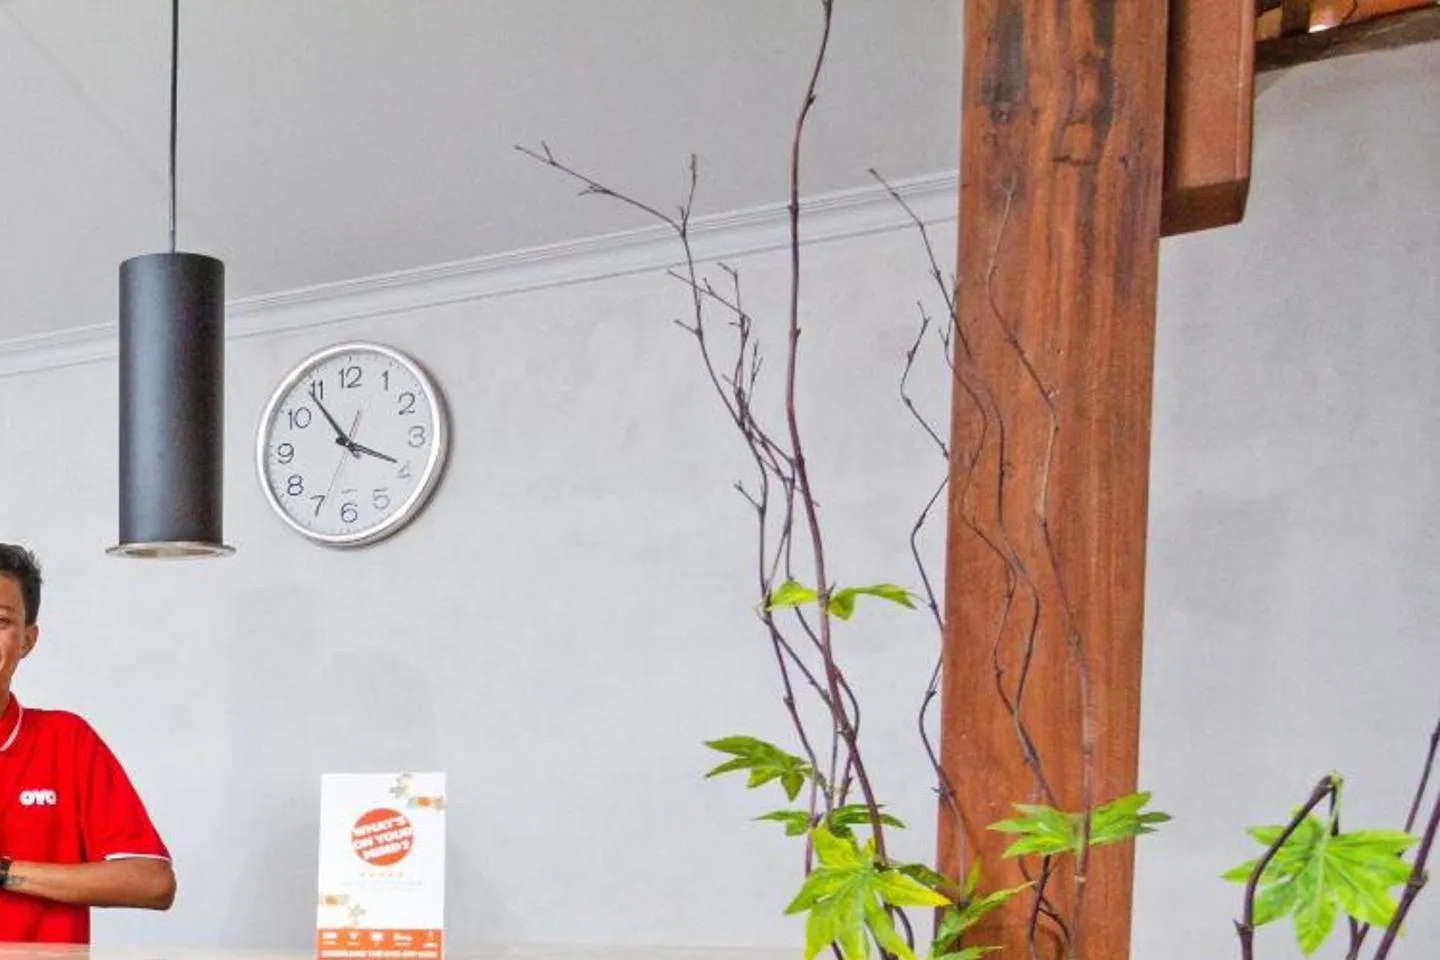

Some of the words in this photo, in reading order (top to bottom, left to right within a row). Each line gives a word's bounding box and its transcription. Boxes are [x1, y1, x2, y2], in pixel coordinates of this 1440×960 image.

[339, 366, 362, 389] 12
[381, 370, 389, 391] 1
[310, 379, 323, 400] 11
[397, 392, 416, 416] 2
[287, 407, 312, 430] 10
[407, 425, 426, 448] 3
[277, 443, 295, 464] 9
[287, 474, 304, 496] 8
[310, 495, 326, 517] 7
[371, 487, 390, 510] 5
[341, 502, 358, 523] 6
[375, 826, 413, 845] YOUR
